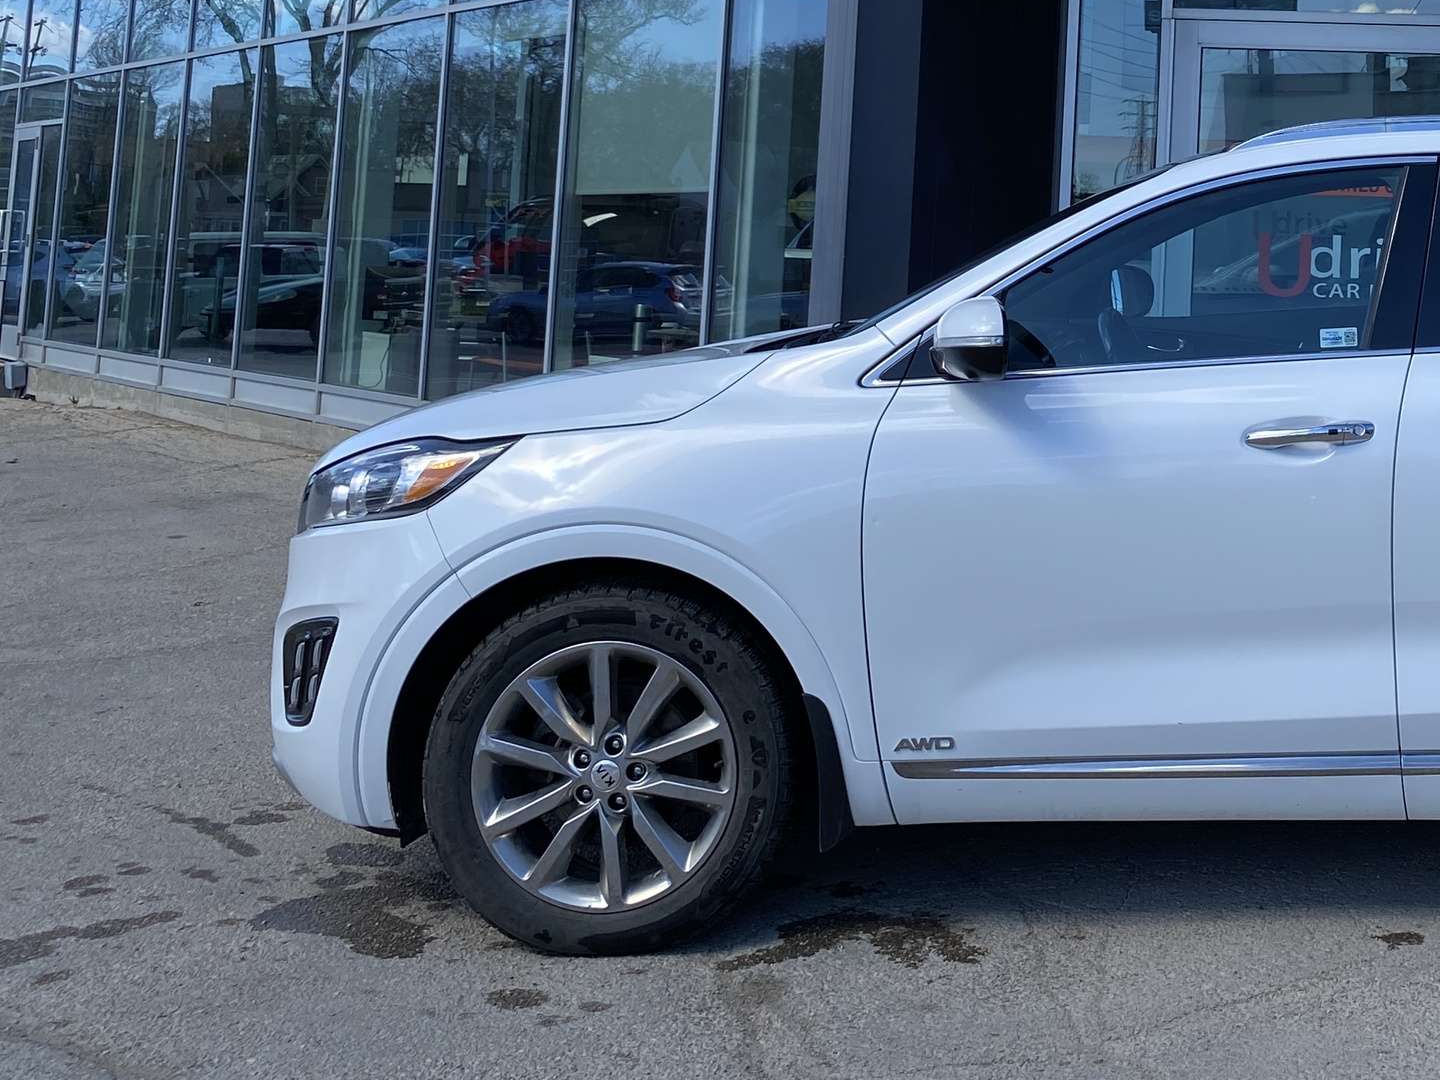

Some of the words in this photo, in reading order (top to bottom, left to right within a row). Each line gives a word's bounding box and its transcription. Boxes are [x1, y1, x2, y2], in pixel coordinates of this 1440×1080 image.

[1312, 282, 1360, 299] CAR
[893, 736, 956, 753] AWD
[596, 763, 617, 788] KIA
